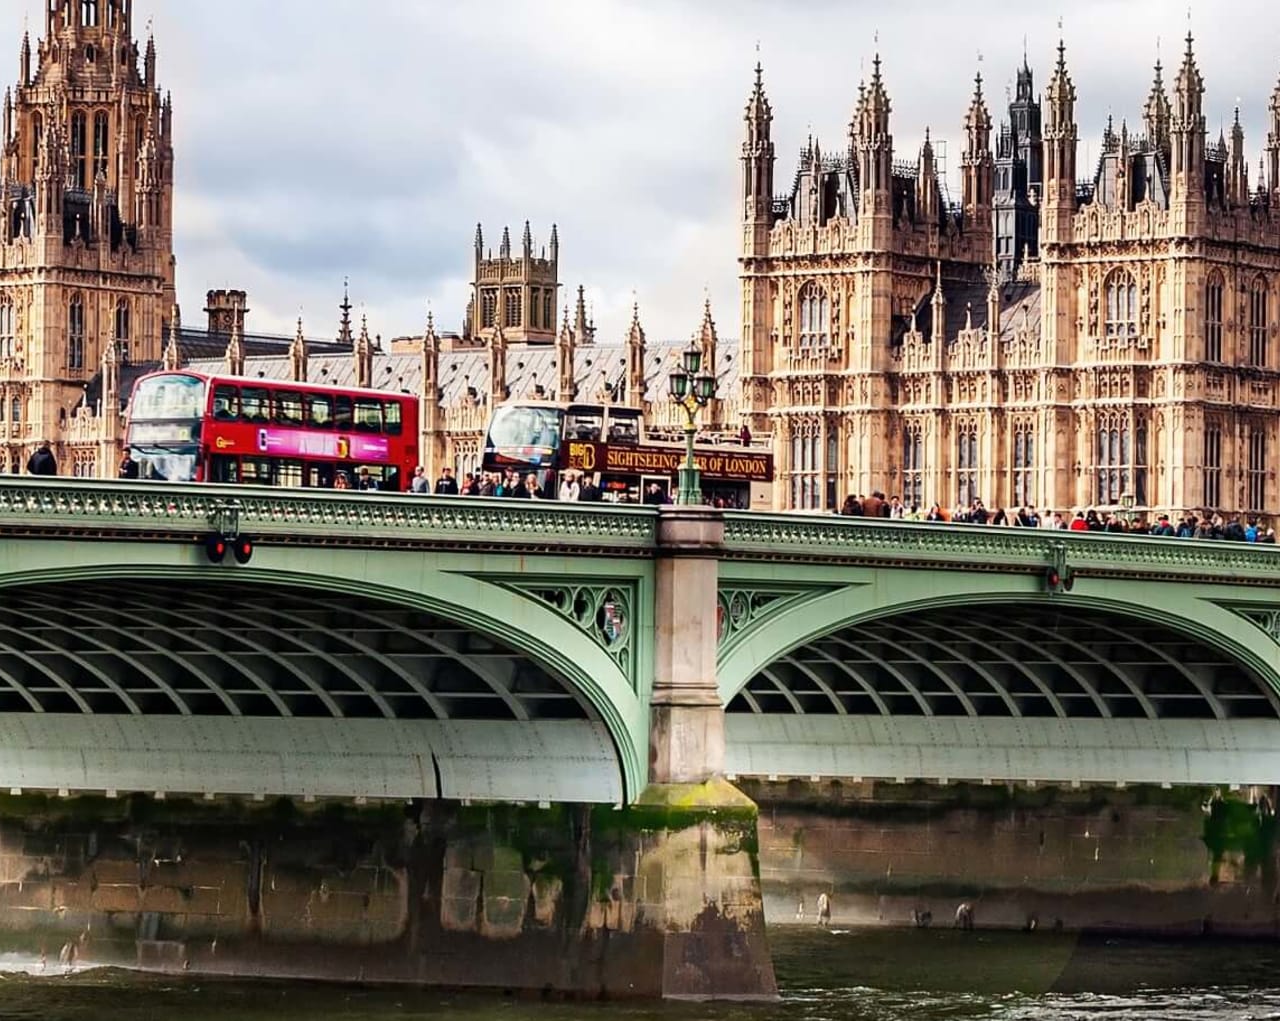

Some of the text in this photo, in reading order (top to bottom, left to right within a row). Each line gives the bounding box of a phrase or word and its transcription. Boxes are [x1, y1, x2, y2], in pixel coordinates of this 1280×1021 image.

[569, 443, 584, 457] BIG
[607, 451, 677, 469] SIGHTSEEING
[709, 457, 724, 472] OF
[725, 458, 767, 474] LONDON
